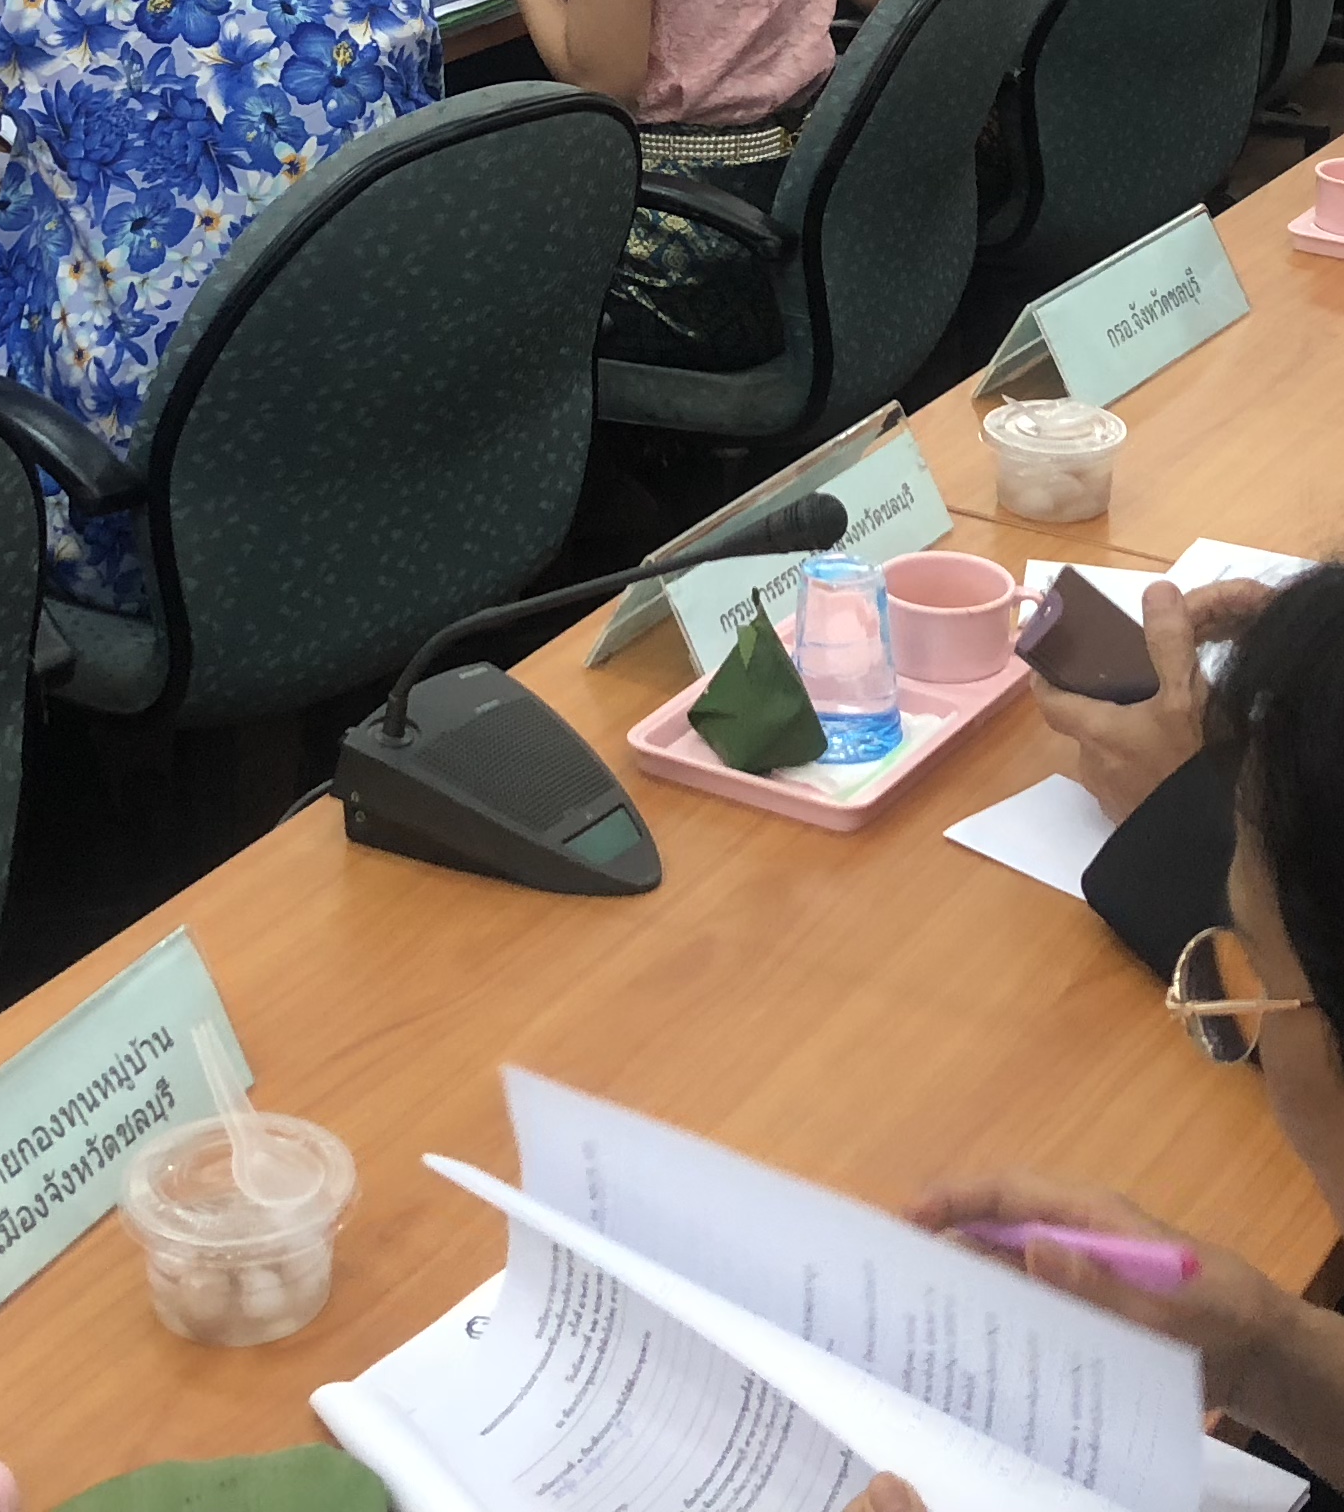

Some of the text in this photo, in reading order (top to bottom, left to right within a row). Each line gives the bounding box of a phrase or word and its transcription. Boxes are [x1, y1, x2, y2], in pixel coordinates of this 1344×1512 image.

[1106, 266, 1202, 349] กรอ.จังหวัดชลบุรี
